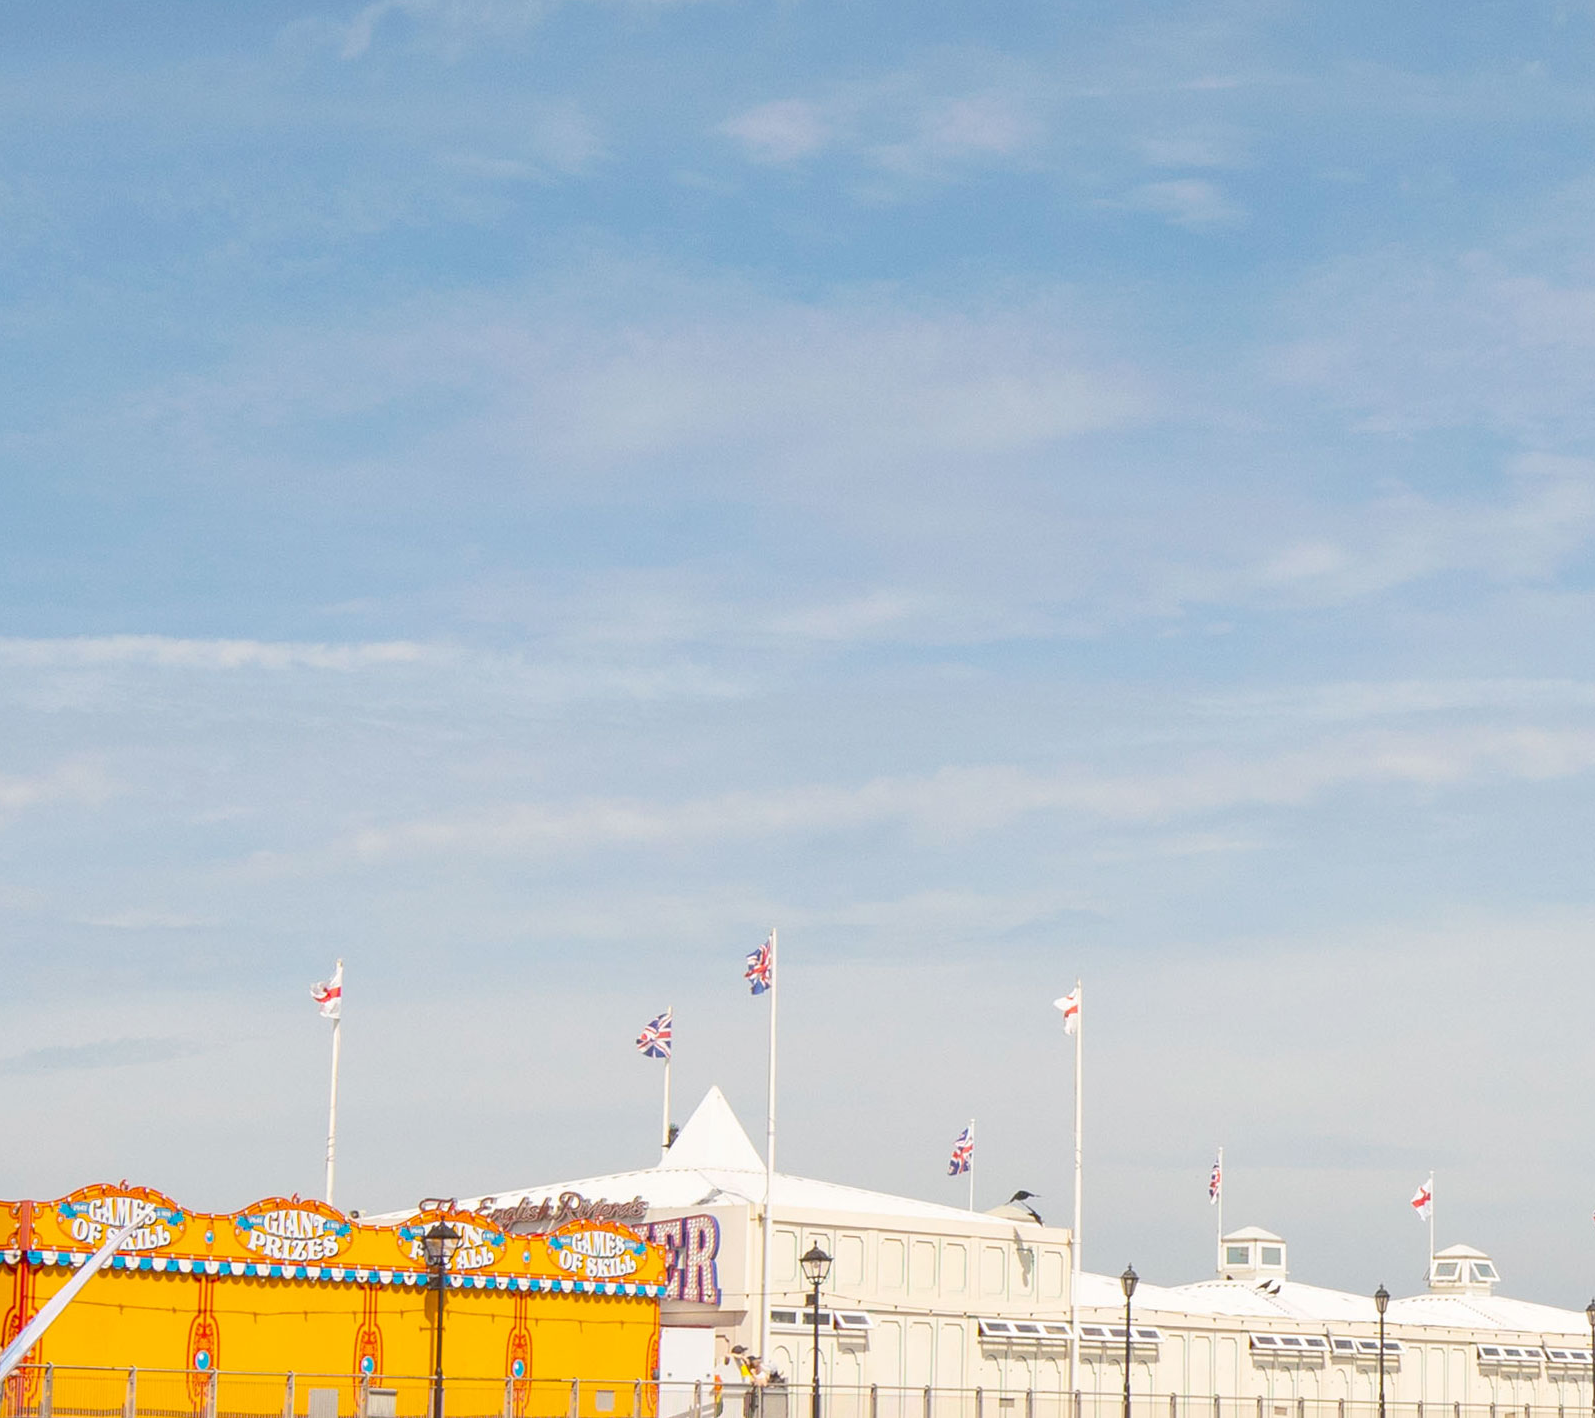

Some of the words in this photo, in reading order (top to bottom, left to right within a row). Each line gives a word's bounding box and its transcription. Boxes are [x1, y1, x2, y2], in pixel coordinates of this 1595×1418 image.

[89, 1197, 157, 1226] GAMES
[264, 1210, 326, 1238] GIANT
[72, 1218, 102, 1244] OF
[247, 1229, 339, 1261] PRIZES
[572, 1230, 625, 1257] GAMES
[457, 1246, 494, 1269] ALL
[560, 1250, 583, 1272] OF
[587, 1255, 636, 1278] SKILL
